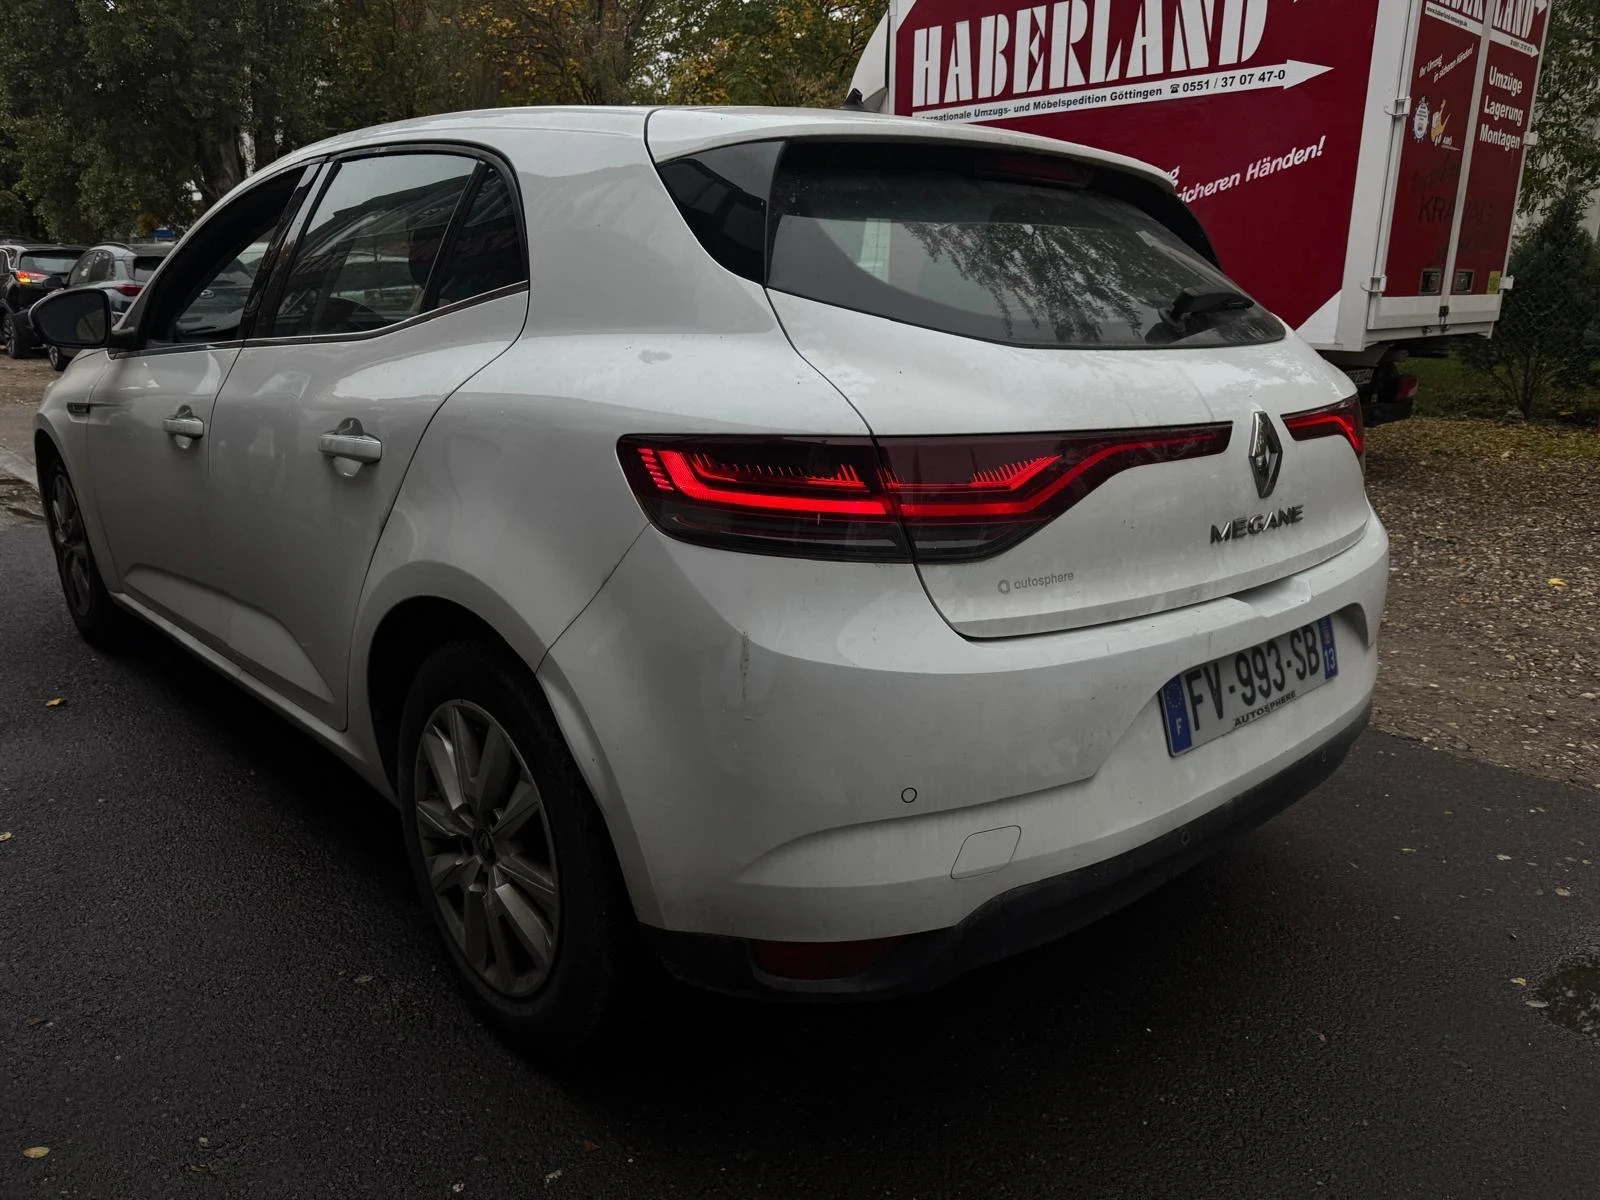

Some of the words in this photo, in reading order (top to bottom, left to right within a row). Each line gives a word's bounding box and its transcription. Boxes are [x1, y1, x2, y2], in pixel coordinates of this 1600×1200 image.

[912, 0, 1268, 108] HABERLAND
[974, 106, 1011, 118] Umzugs-
[1014, 103, 1030, 113] und
[1033, 93, 1107, 111] Möbelspedition
[1110, 86, 1162, 102] Göttingen
[1182, 79, 1210, 93] 0551
[1221, 75, 1236, 88] 37
[1239, 72, 1255, 85] 07
[1258, 69, 1286, 83] 47-0
[1489, 65, 1523, 96] Umzüge
[1484, 95, 1524, 127] Lagerung
[1480, 123, 1521, 151] Montagen
[1246, 135, 1326, 182] Händen!
[1210, 505, 1305, 544] MEGANE
[1014, 570, 1075, 590] autosphere
[1324, 647, 1336, 672] 13
[1185, 624, 1320, 731] FV-993-SB
[1233, 690, 1296, 727] AUTOSPHERE
[1175, 717, 1183, 735] F
